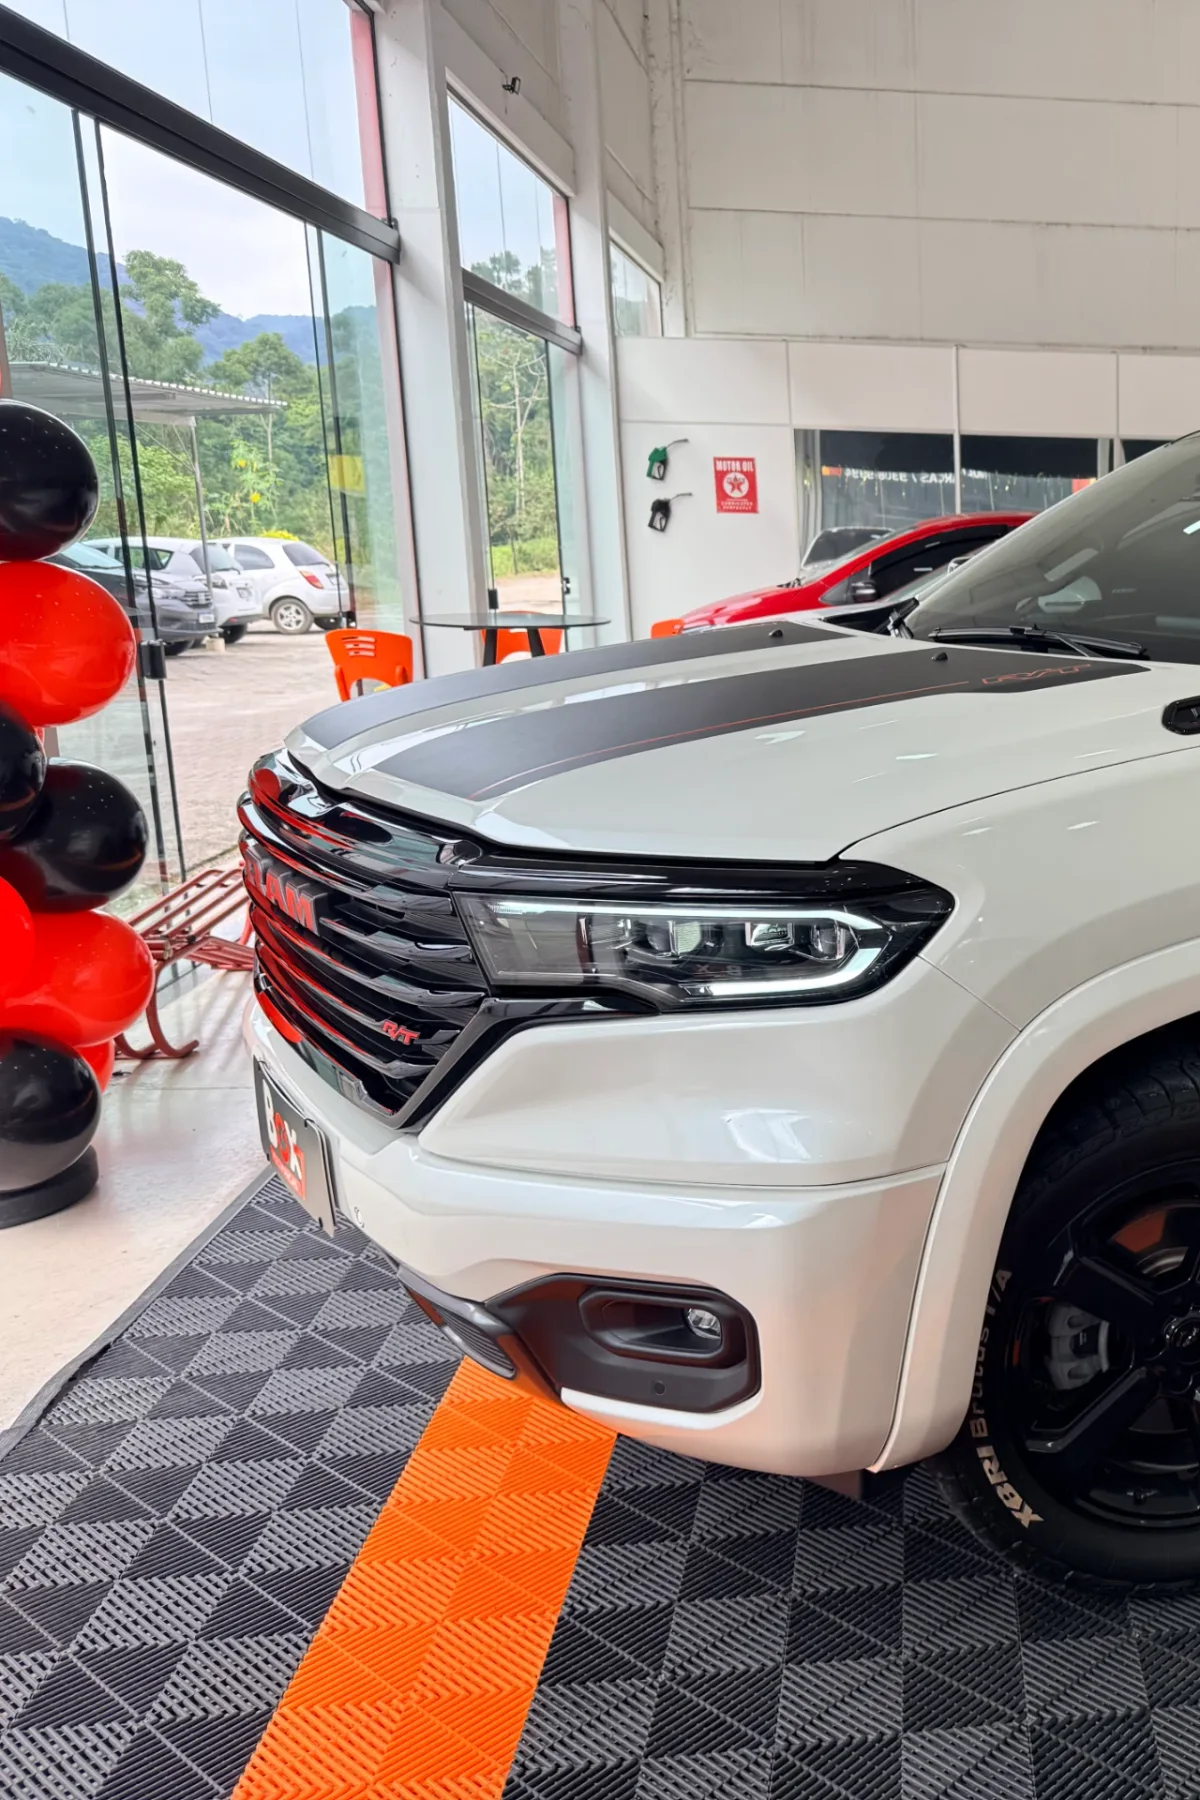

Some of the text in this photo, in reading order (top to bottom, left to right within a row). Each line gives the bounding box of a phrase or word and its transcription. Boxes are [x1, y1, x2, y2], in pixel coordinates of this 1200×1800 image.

[716, 460, 754, 472] MOTOR OIL
[381, 1019, 421, 1046] R/T
